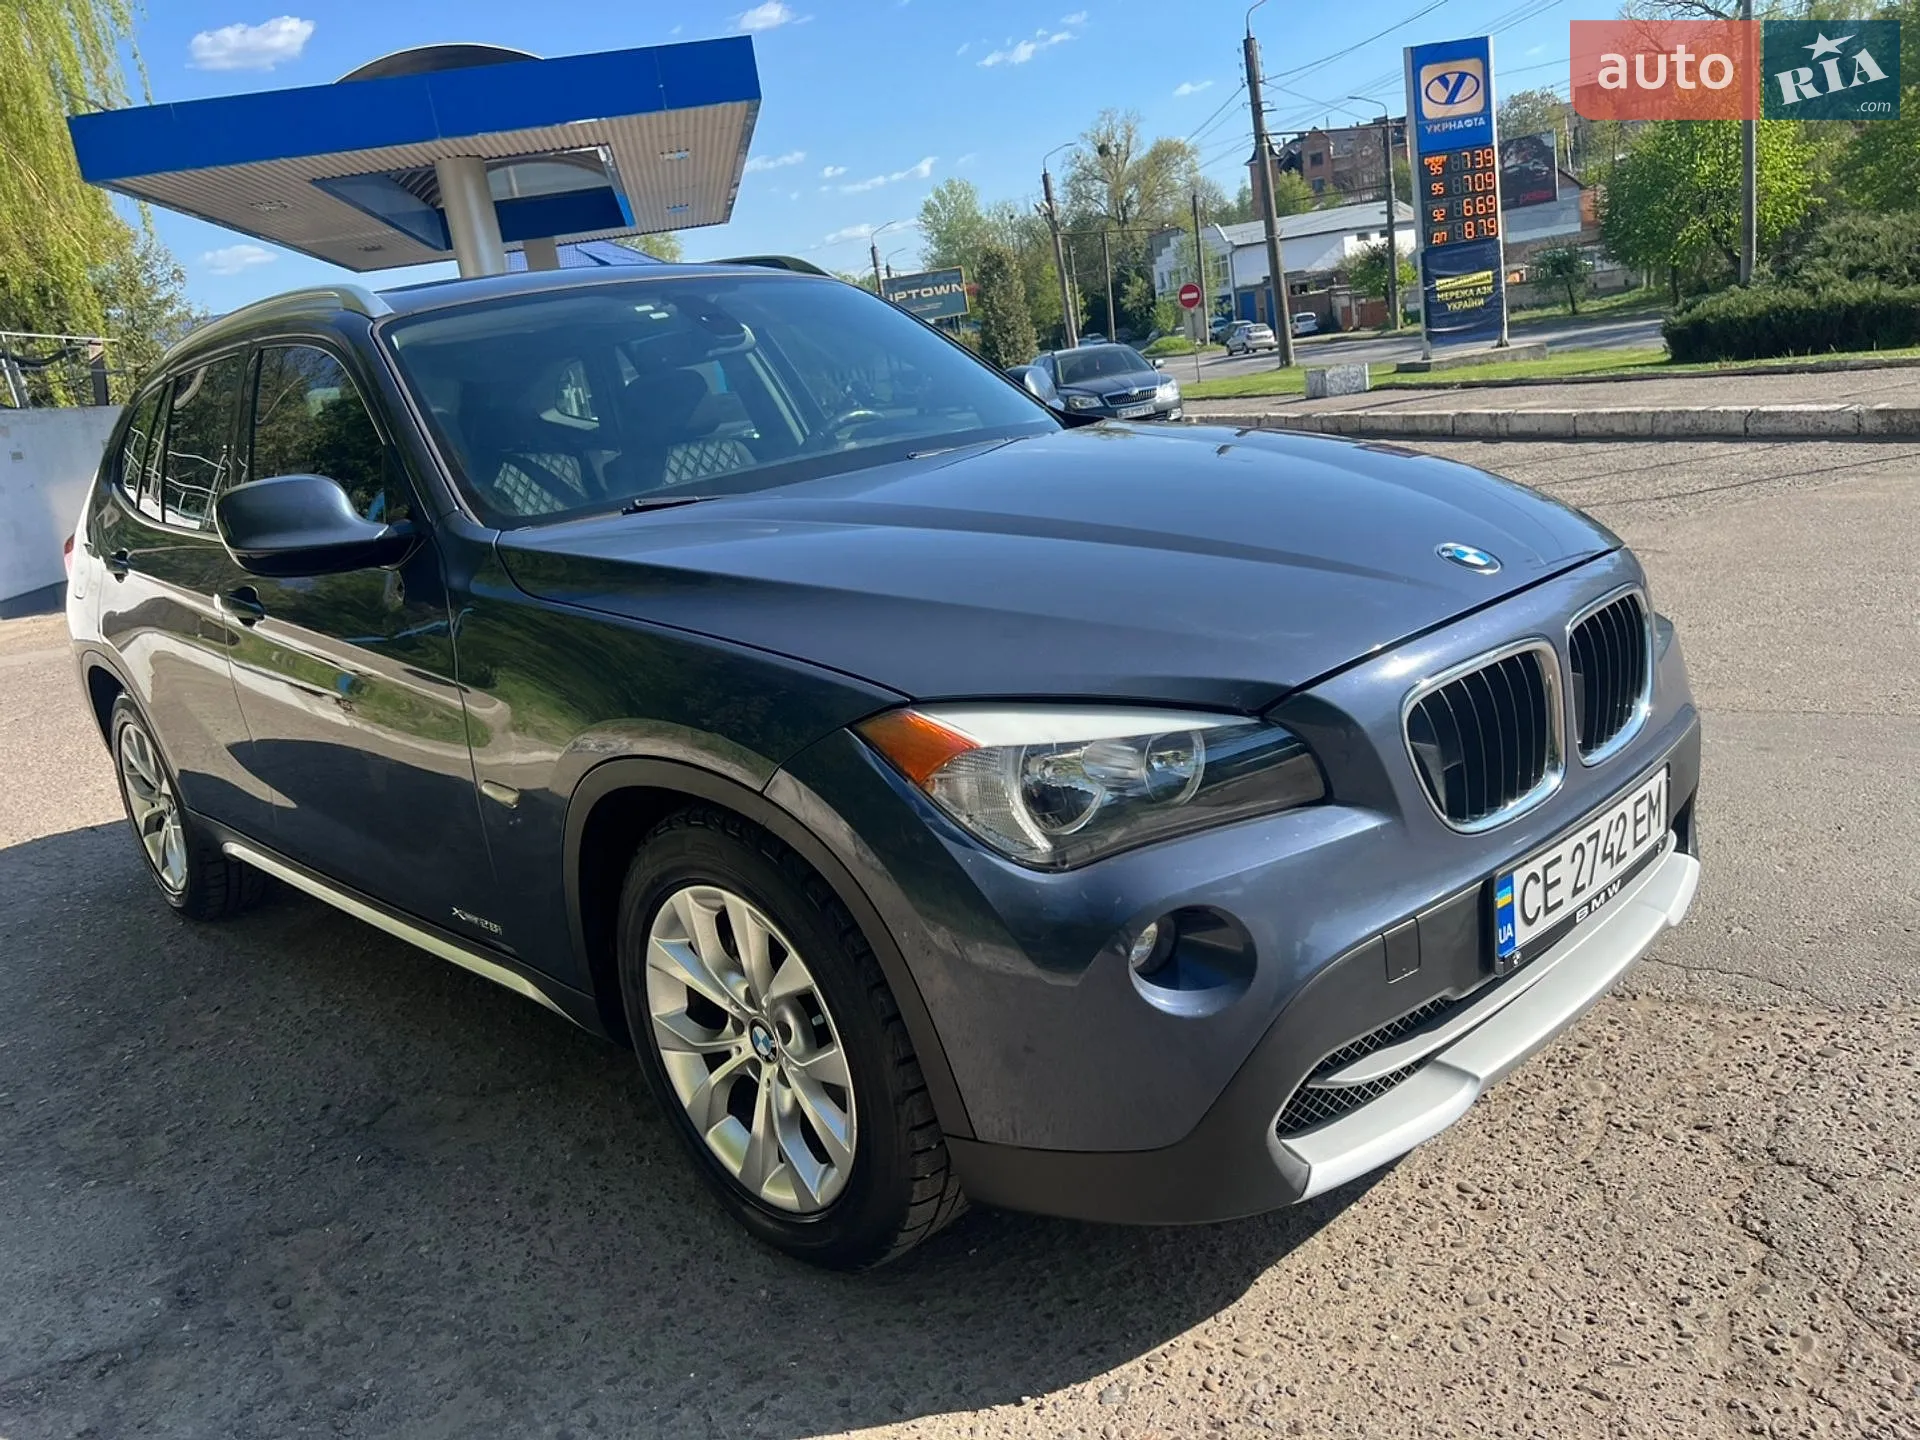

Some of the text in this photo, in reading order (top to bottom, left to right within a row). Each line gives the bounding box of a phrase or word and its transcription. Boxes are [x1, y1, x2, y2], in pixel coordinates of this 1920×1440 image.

[1425, 117, 1486, 134] УКРНАФТА
[1431, 182, 1445, 196] 95
[1432, 208, 1446, 222] 92
[1521, 780, 1663, 927] CE 2742 EM
[1575, 878, 1622, 923] BMW
[1498, 923, 1514, 944] UA
